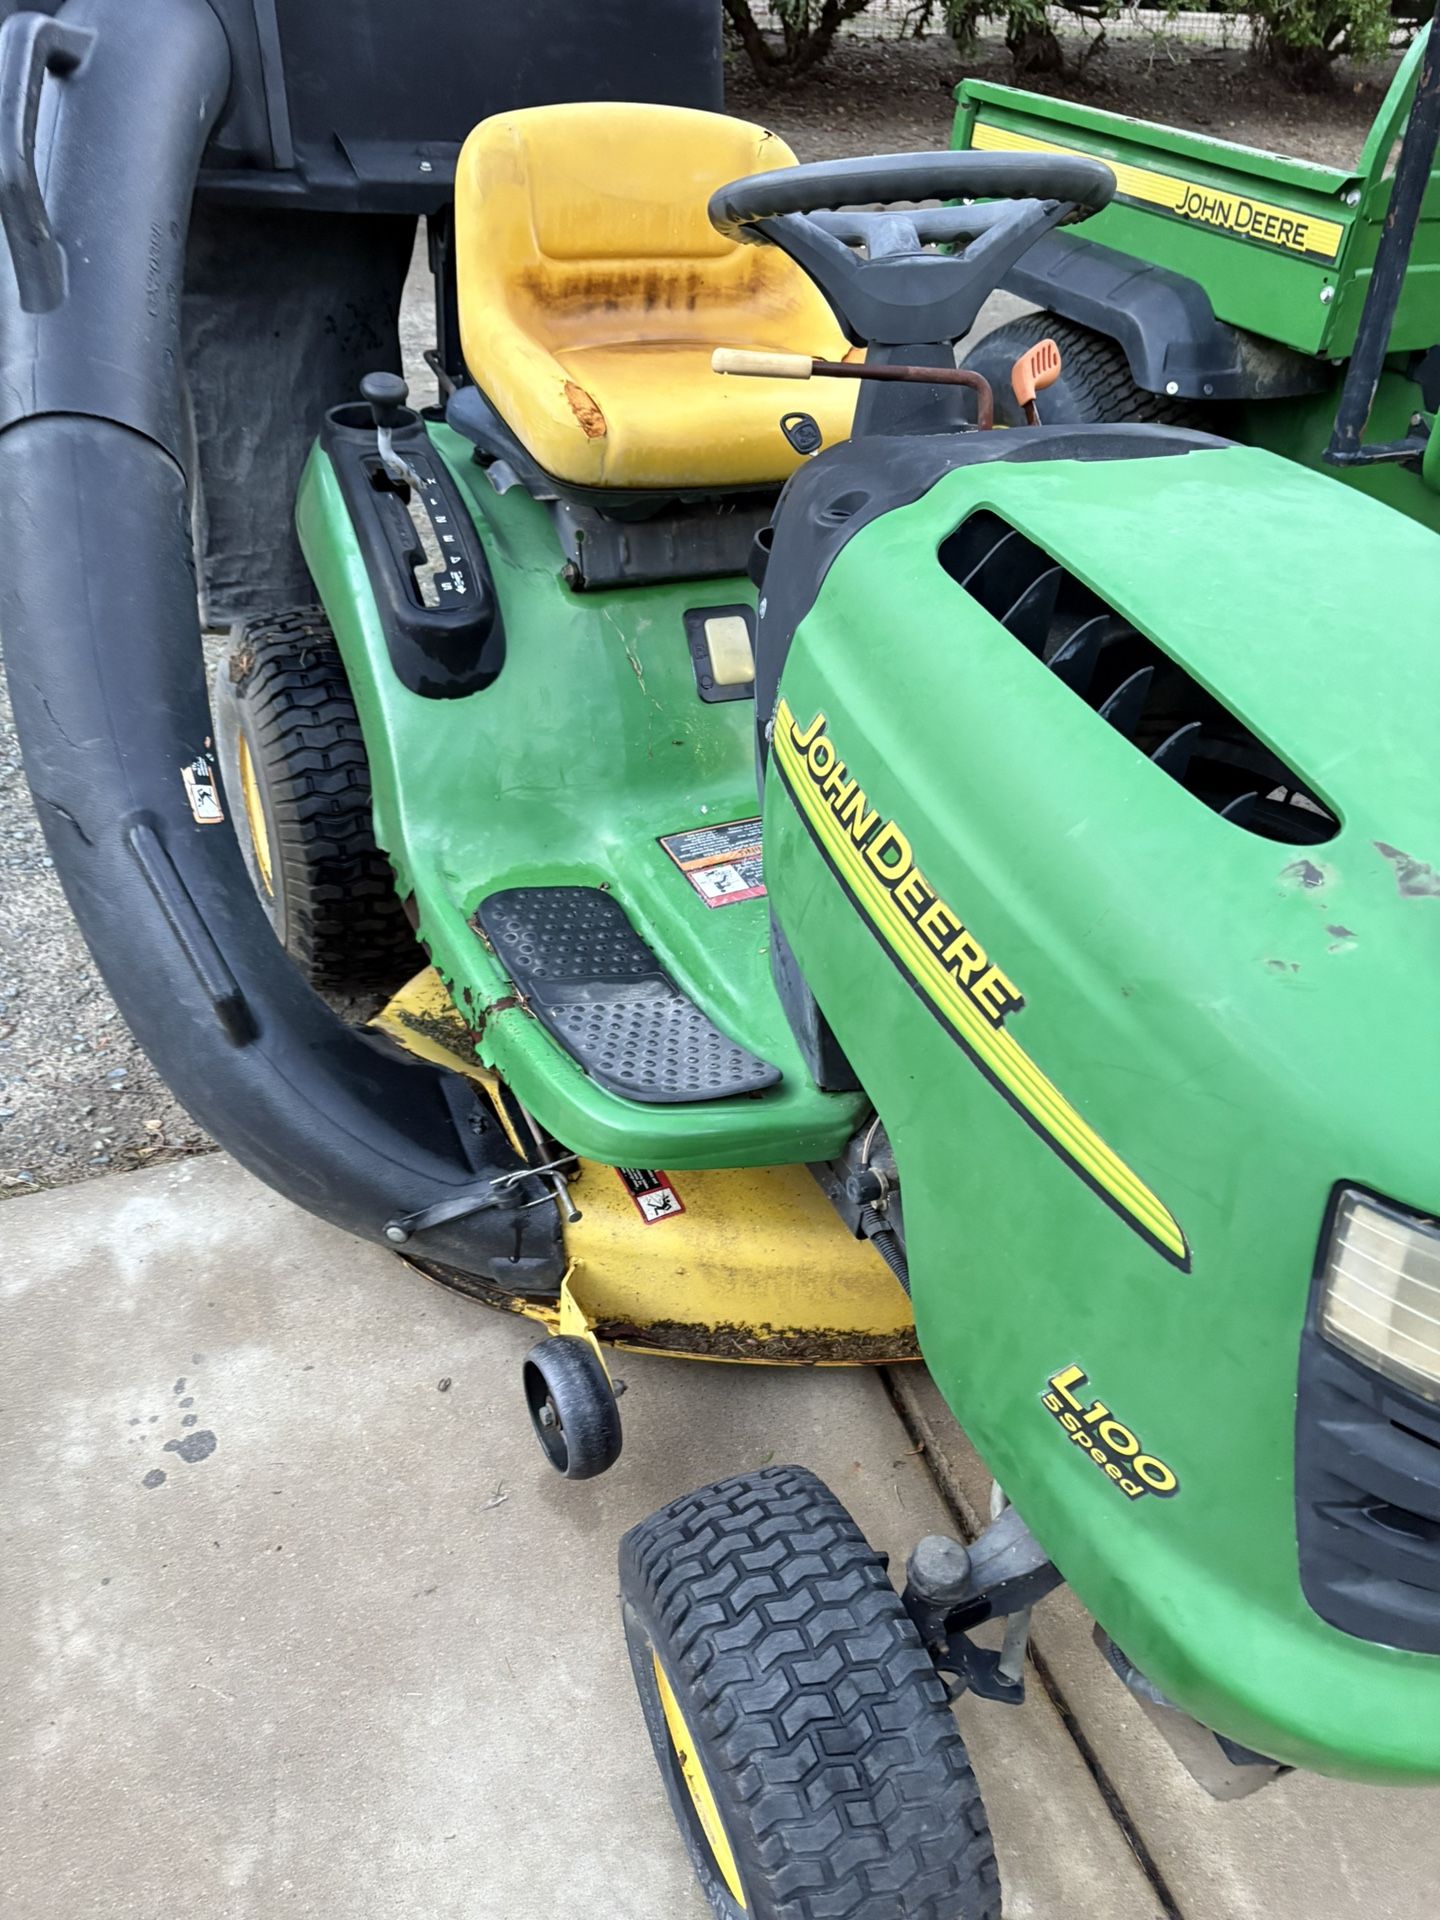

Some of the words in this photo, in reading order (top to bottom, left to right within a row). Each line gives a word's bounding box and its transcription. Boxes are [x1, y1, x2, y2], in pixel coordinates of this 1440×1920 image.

[1175, 186, 1233, 225] JOHN
[1234, 201, 1309, 247] DEERE
[791, 713, 881, 845] JOHN
[864, 819, 1024, 1021] DEERE
[1050, 1365, 1177, 1491] L100
